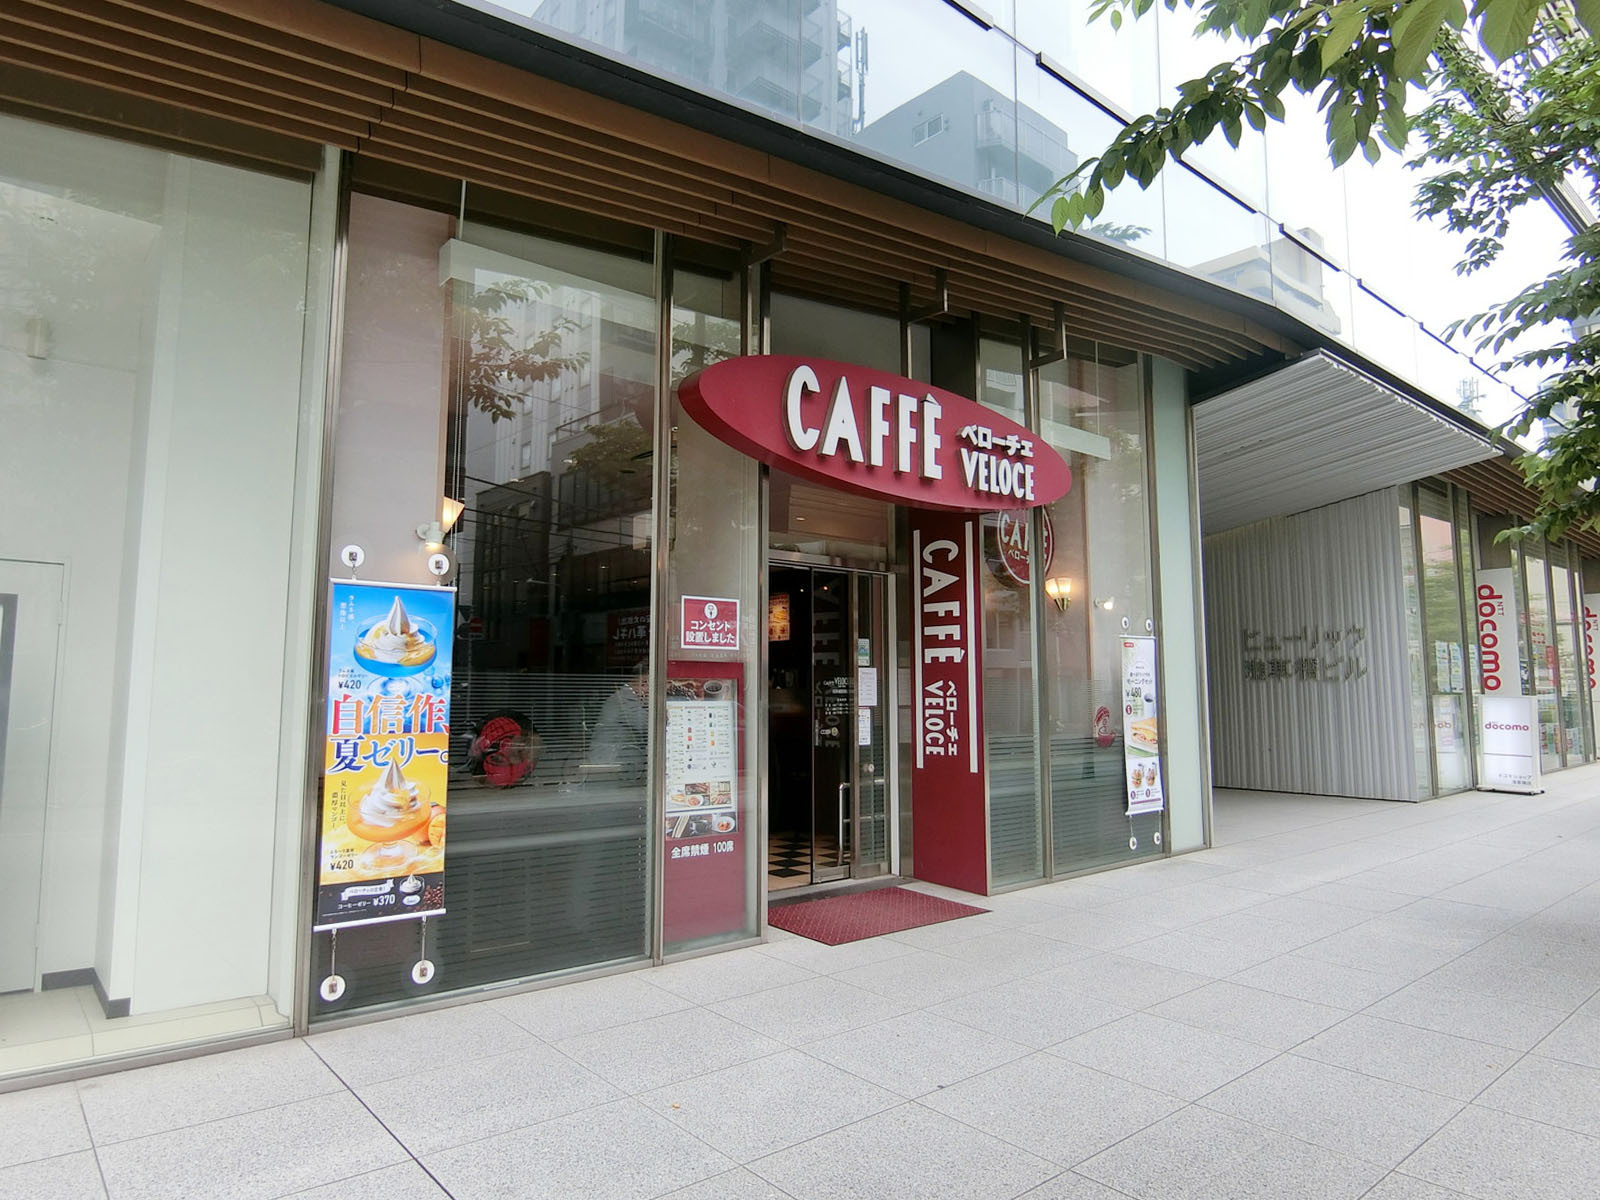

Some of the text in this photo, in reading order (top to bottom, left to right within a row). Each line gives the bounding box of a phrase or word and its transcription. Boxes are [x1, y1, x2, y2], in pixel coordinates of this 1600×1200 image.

[960, 424, 1034, 458] ベローチェ
[960, 449, 1035, 502] VELOCE
[1497, 601, 1505, 616] NTT
[685, 631, 735, 644] 設置しました
[690, 620, 731, 632] コンセント
[1242, 624, 1366, 651] ヒューリック
[1478, 584, 1503, 691] docomo
[338, 679, 361, 690] ¥420
[332, 694, 450, 735] 自信作、
[925, 680, 945, 756] VELOCE
[946, 680, 959, 756] ベローチェ
[1485, 721, 1529, 731] docomo
[328, 735, 449, 773] 夏ゼリー。
[671, 840, 735, 859] 全席禁煙 100席
[330, 859, 354, 870] ¥420
[338, 901, 371, 909] コーヒーゼリー
[373, 894, 396, 906] ¥370
